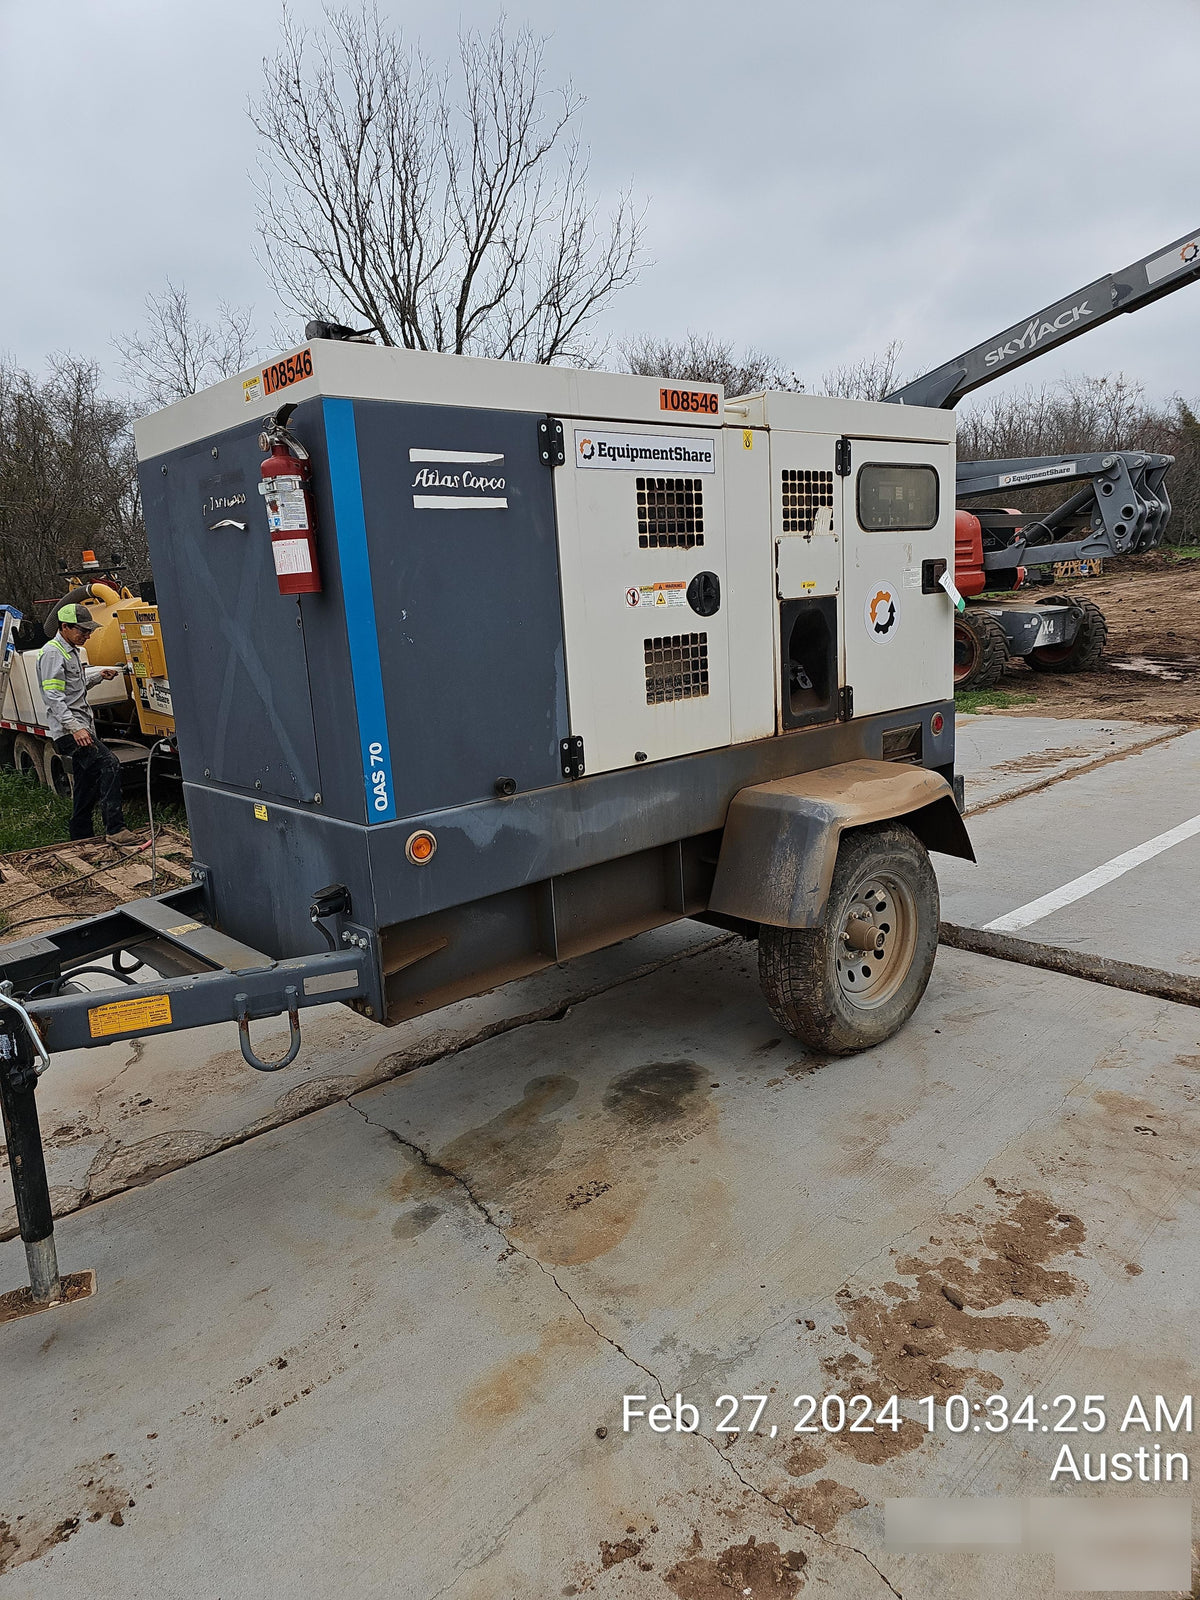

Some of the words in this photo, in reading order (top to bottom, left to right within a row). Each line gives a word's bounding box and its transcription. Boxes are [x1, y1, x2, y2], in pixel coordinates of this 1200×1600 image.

[984, 300, 1094, 367] SKYJACK
[264, 350, 312, 393] 108546
[661, 389, 719, 413] 108546
[597, 442, 712, 463] EquipmentShare
[411, 468, 460, 488] Atlas
[462, 470, 506, 492] Copco
[1012, 467, 1071, 482] EquipmentShare
[369, 742, 384, 767] 70
[371, 770, 388, 812] QAS
